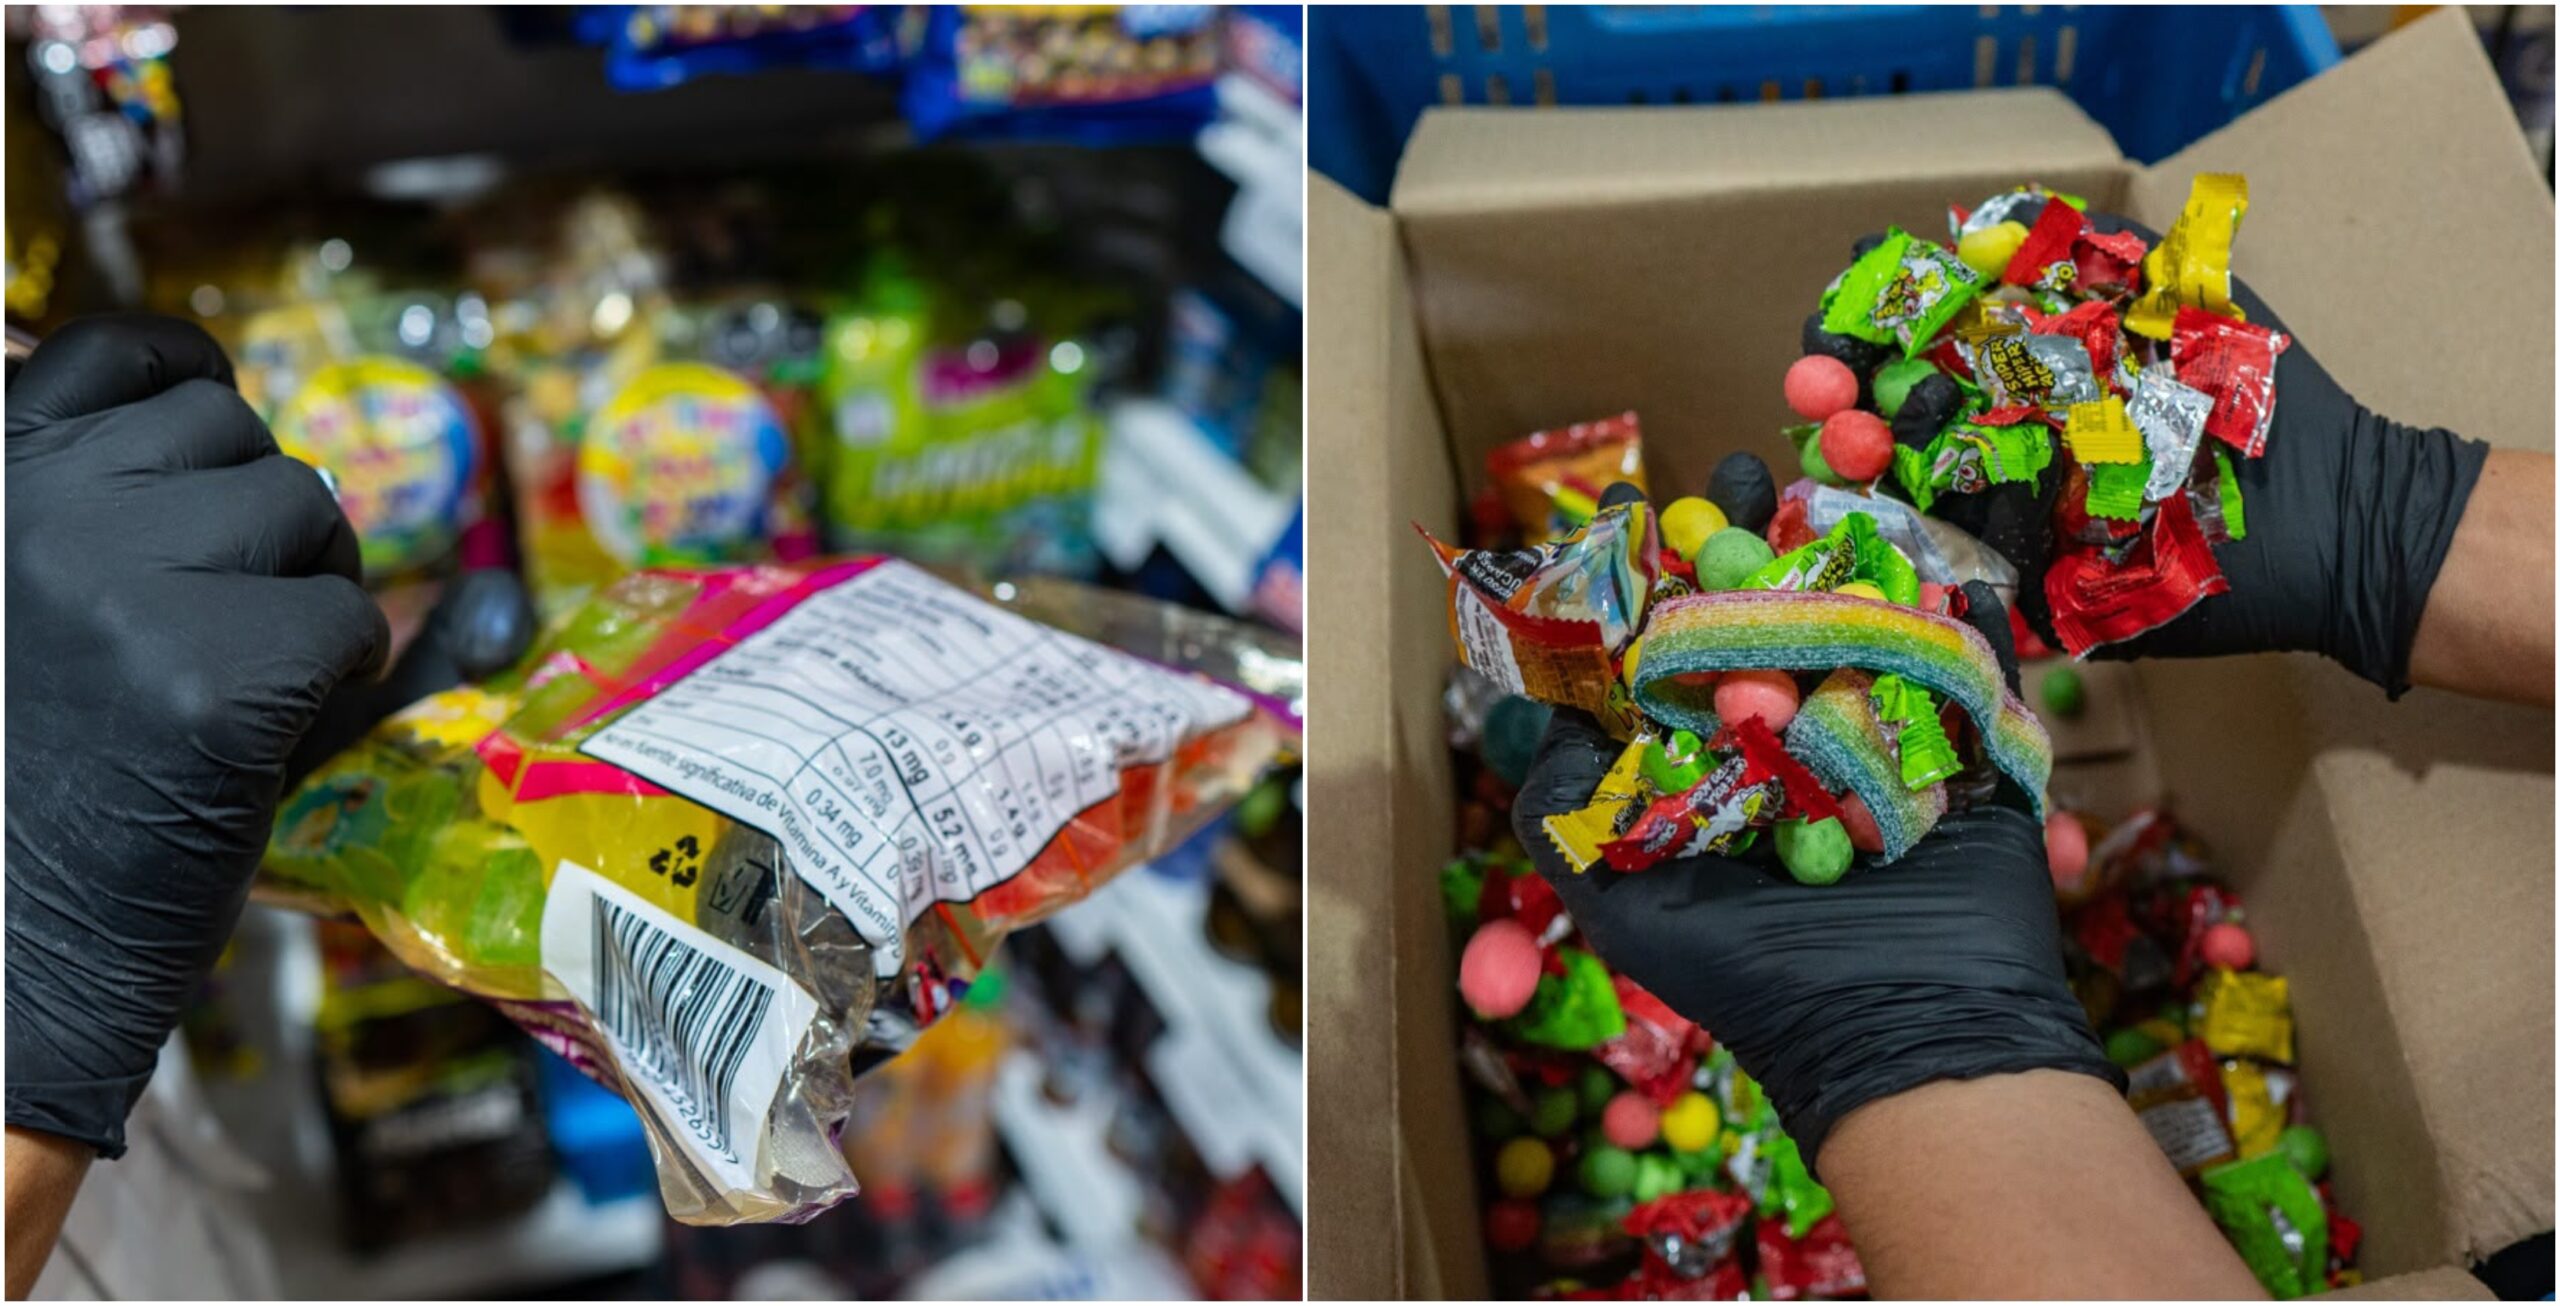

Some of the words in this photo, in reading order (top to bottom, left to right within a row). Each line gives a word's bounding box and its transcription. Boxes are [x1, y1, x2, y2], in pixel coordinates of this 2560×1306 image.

[1990, 339, 2022, 392] SUPER
[2007, 342, 2040, 388] HIPER
[902, 750, 930, 787] mg
[677, 757, 757, 803] significativa
[757, 791, 778, 811] de
[778, 800, 829, 870] Vitamina
[826, 865, 841, 881] A
[835, 877, 852, 890] y
[804, 788, 841, 824] 0.34
[836, 819, 865, 848] mg
[932, 807, 964, 839] 5.2
